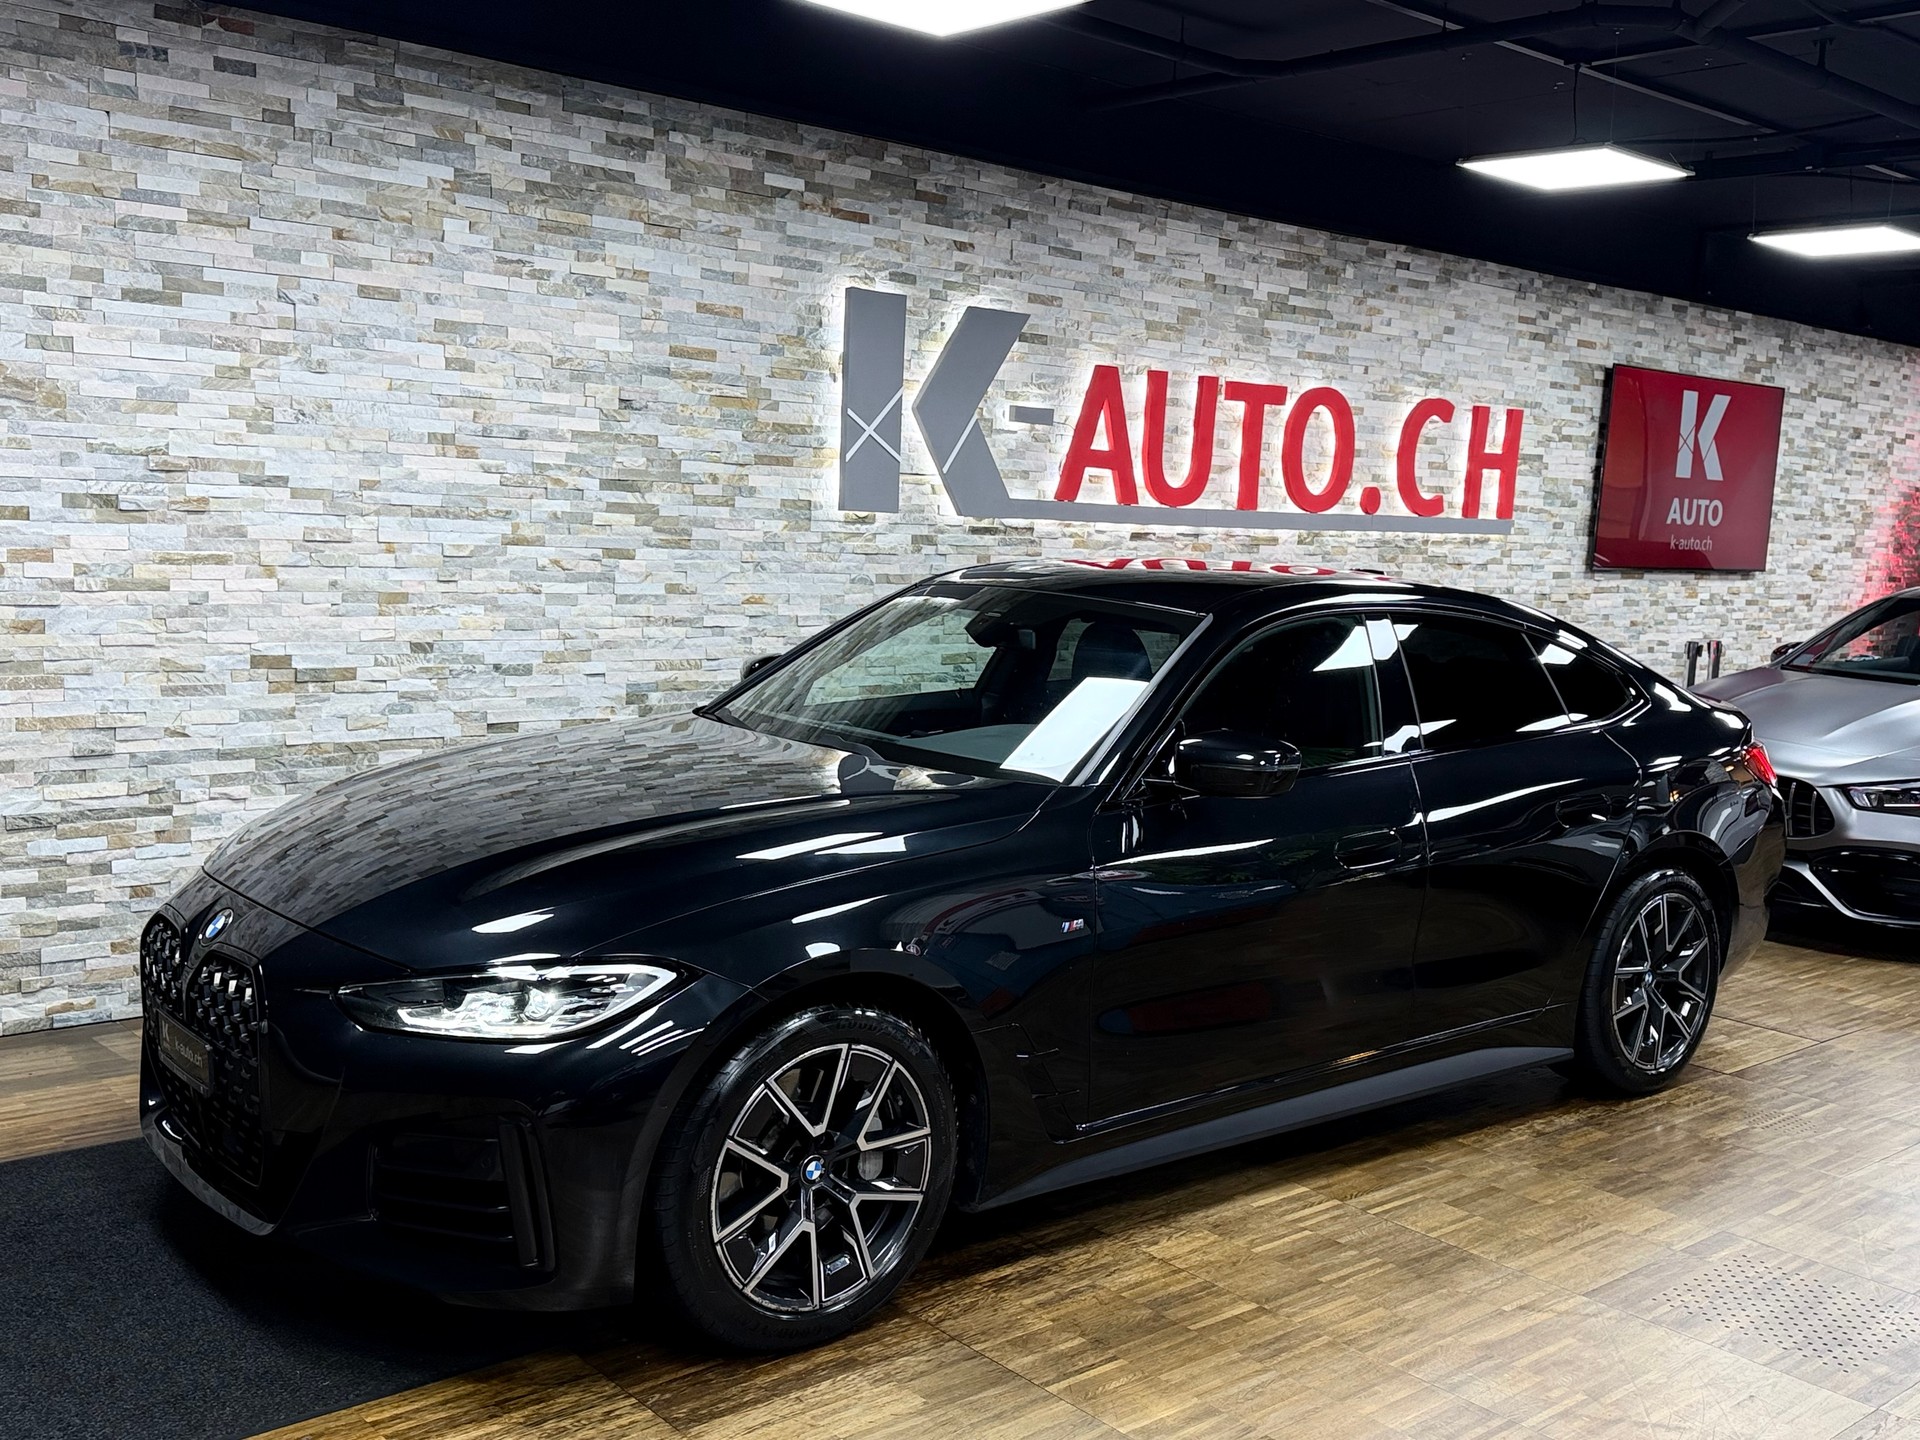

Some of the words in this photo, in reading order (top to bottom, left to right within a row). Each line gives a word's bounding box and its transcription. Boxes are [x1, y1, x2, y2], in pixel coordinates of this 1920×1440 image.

[1675, 390, 1731, 481] K
[1666, 498, 1723, 527] AUTO
[1670, 535, 1712, 551] k-auto.ch
